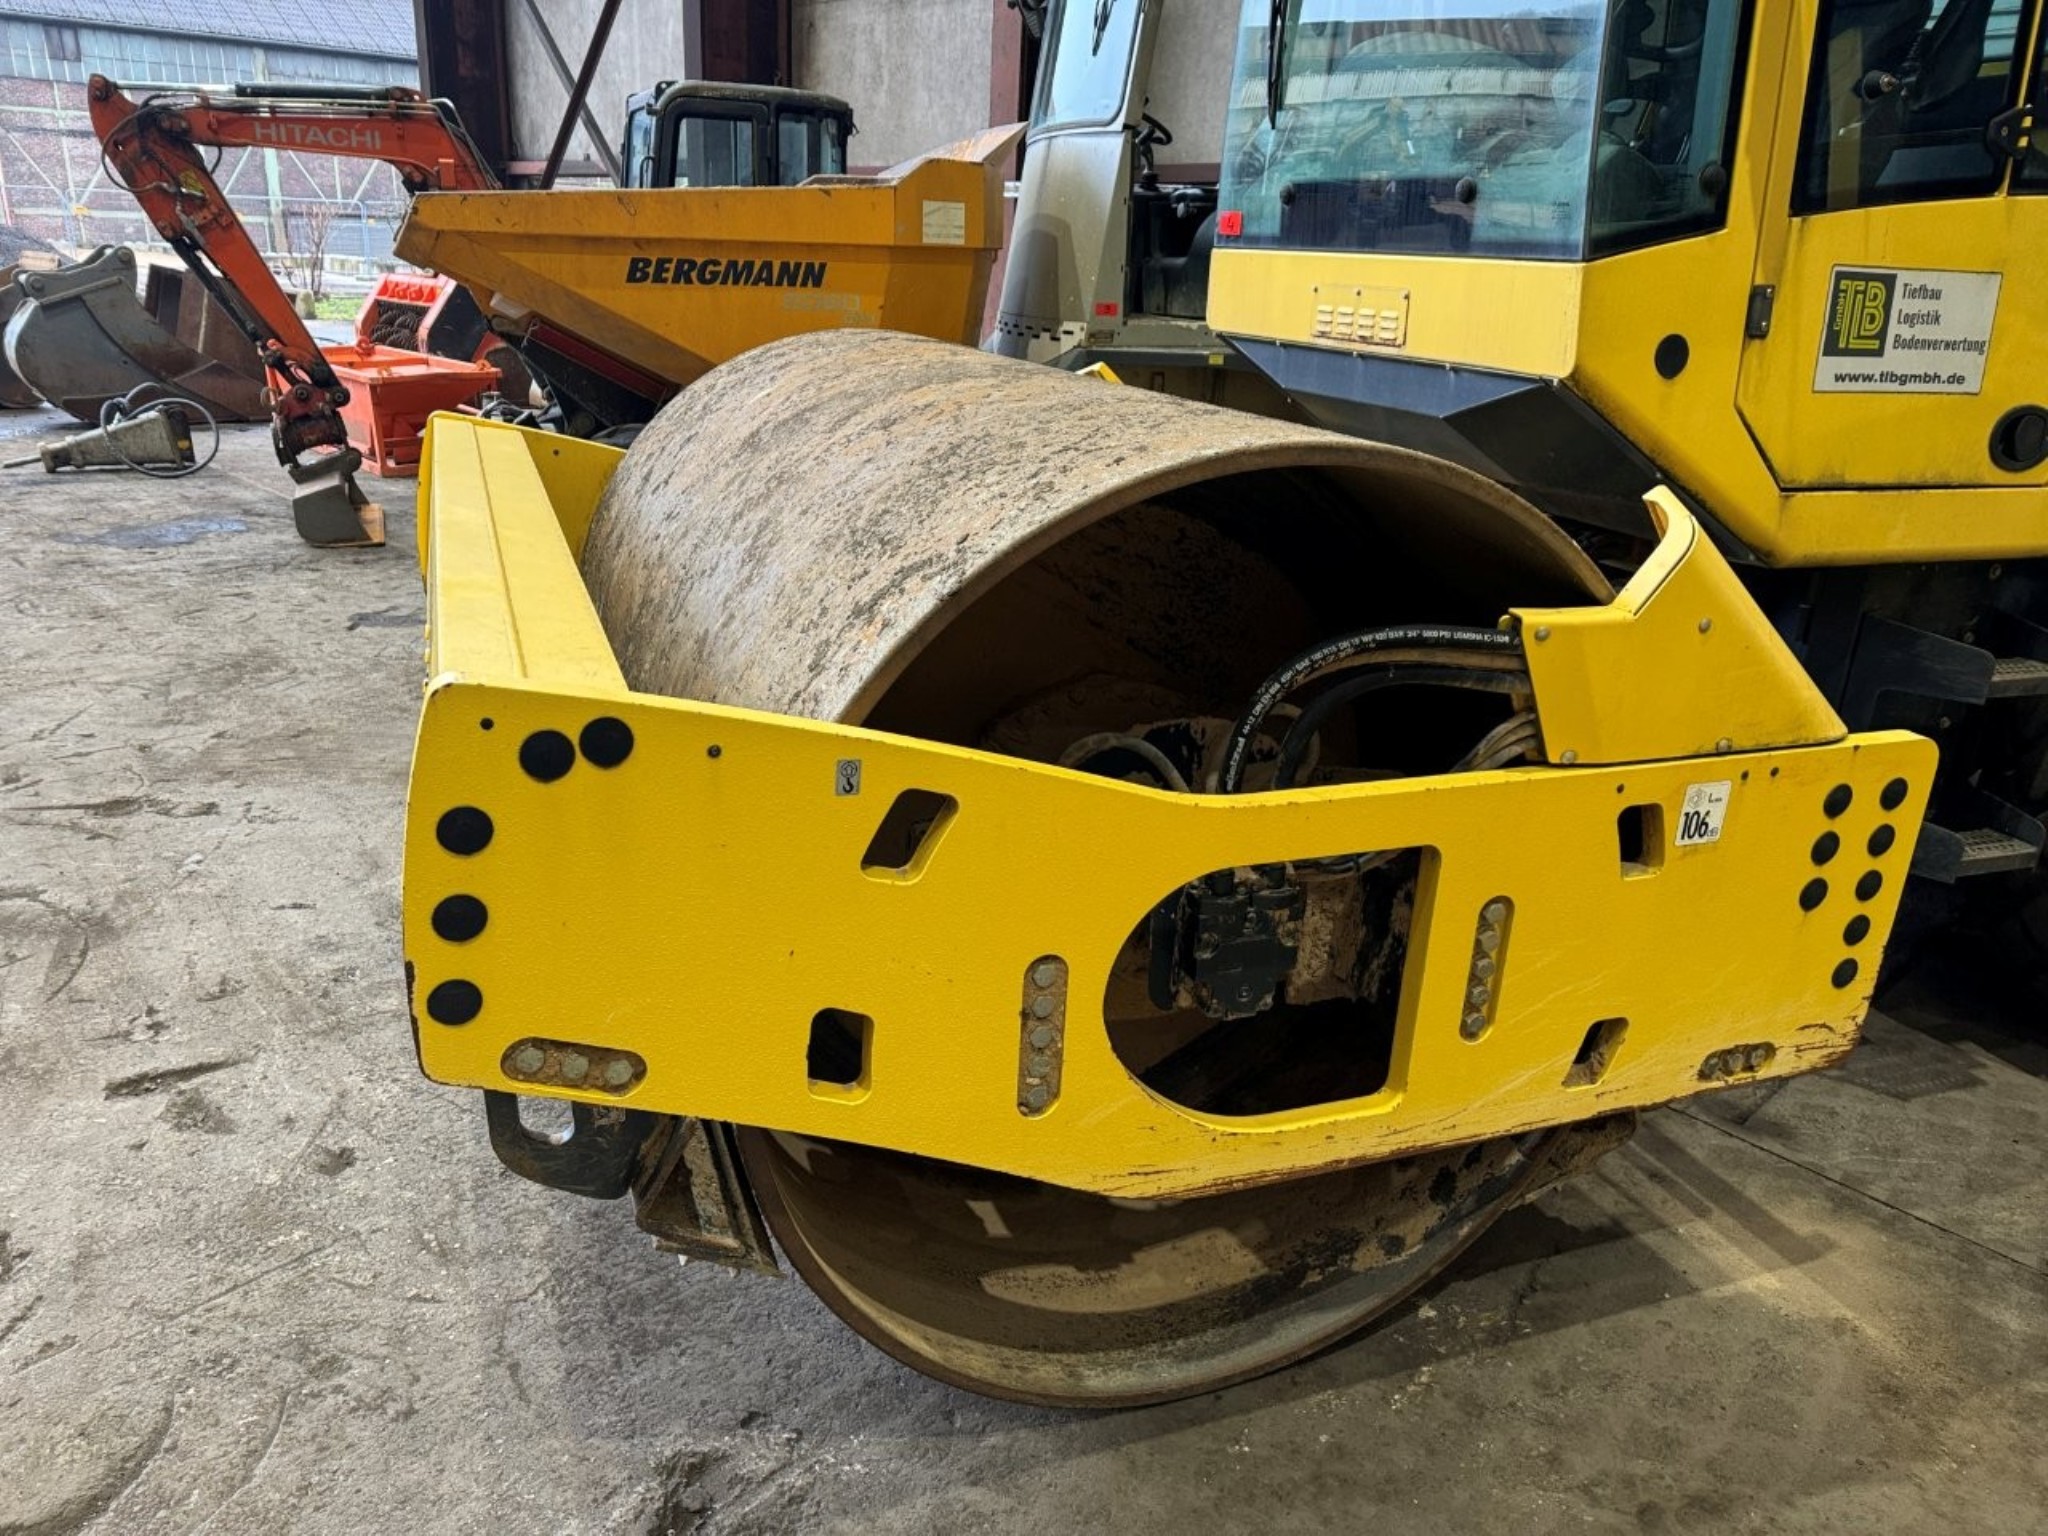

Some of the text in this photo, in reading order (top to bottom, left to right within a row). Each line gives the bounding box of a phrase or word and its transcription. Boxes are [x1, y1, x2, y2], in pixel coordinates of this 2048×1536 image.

[254, 121, 382, 150] HITACHI
[626, 257, 827, 288] BERGMANN
[1902, 283, 1942, 301] Tiefbau
[1897, 309, 1941, 328] Logistik
[1893, 334, 1987, 355] Bodenverwertung
[1834, 371, 1966, 385] www.tlbgmbh.de
[1680, 810, 1711, 840] 106
